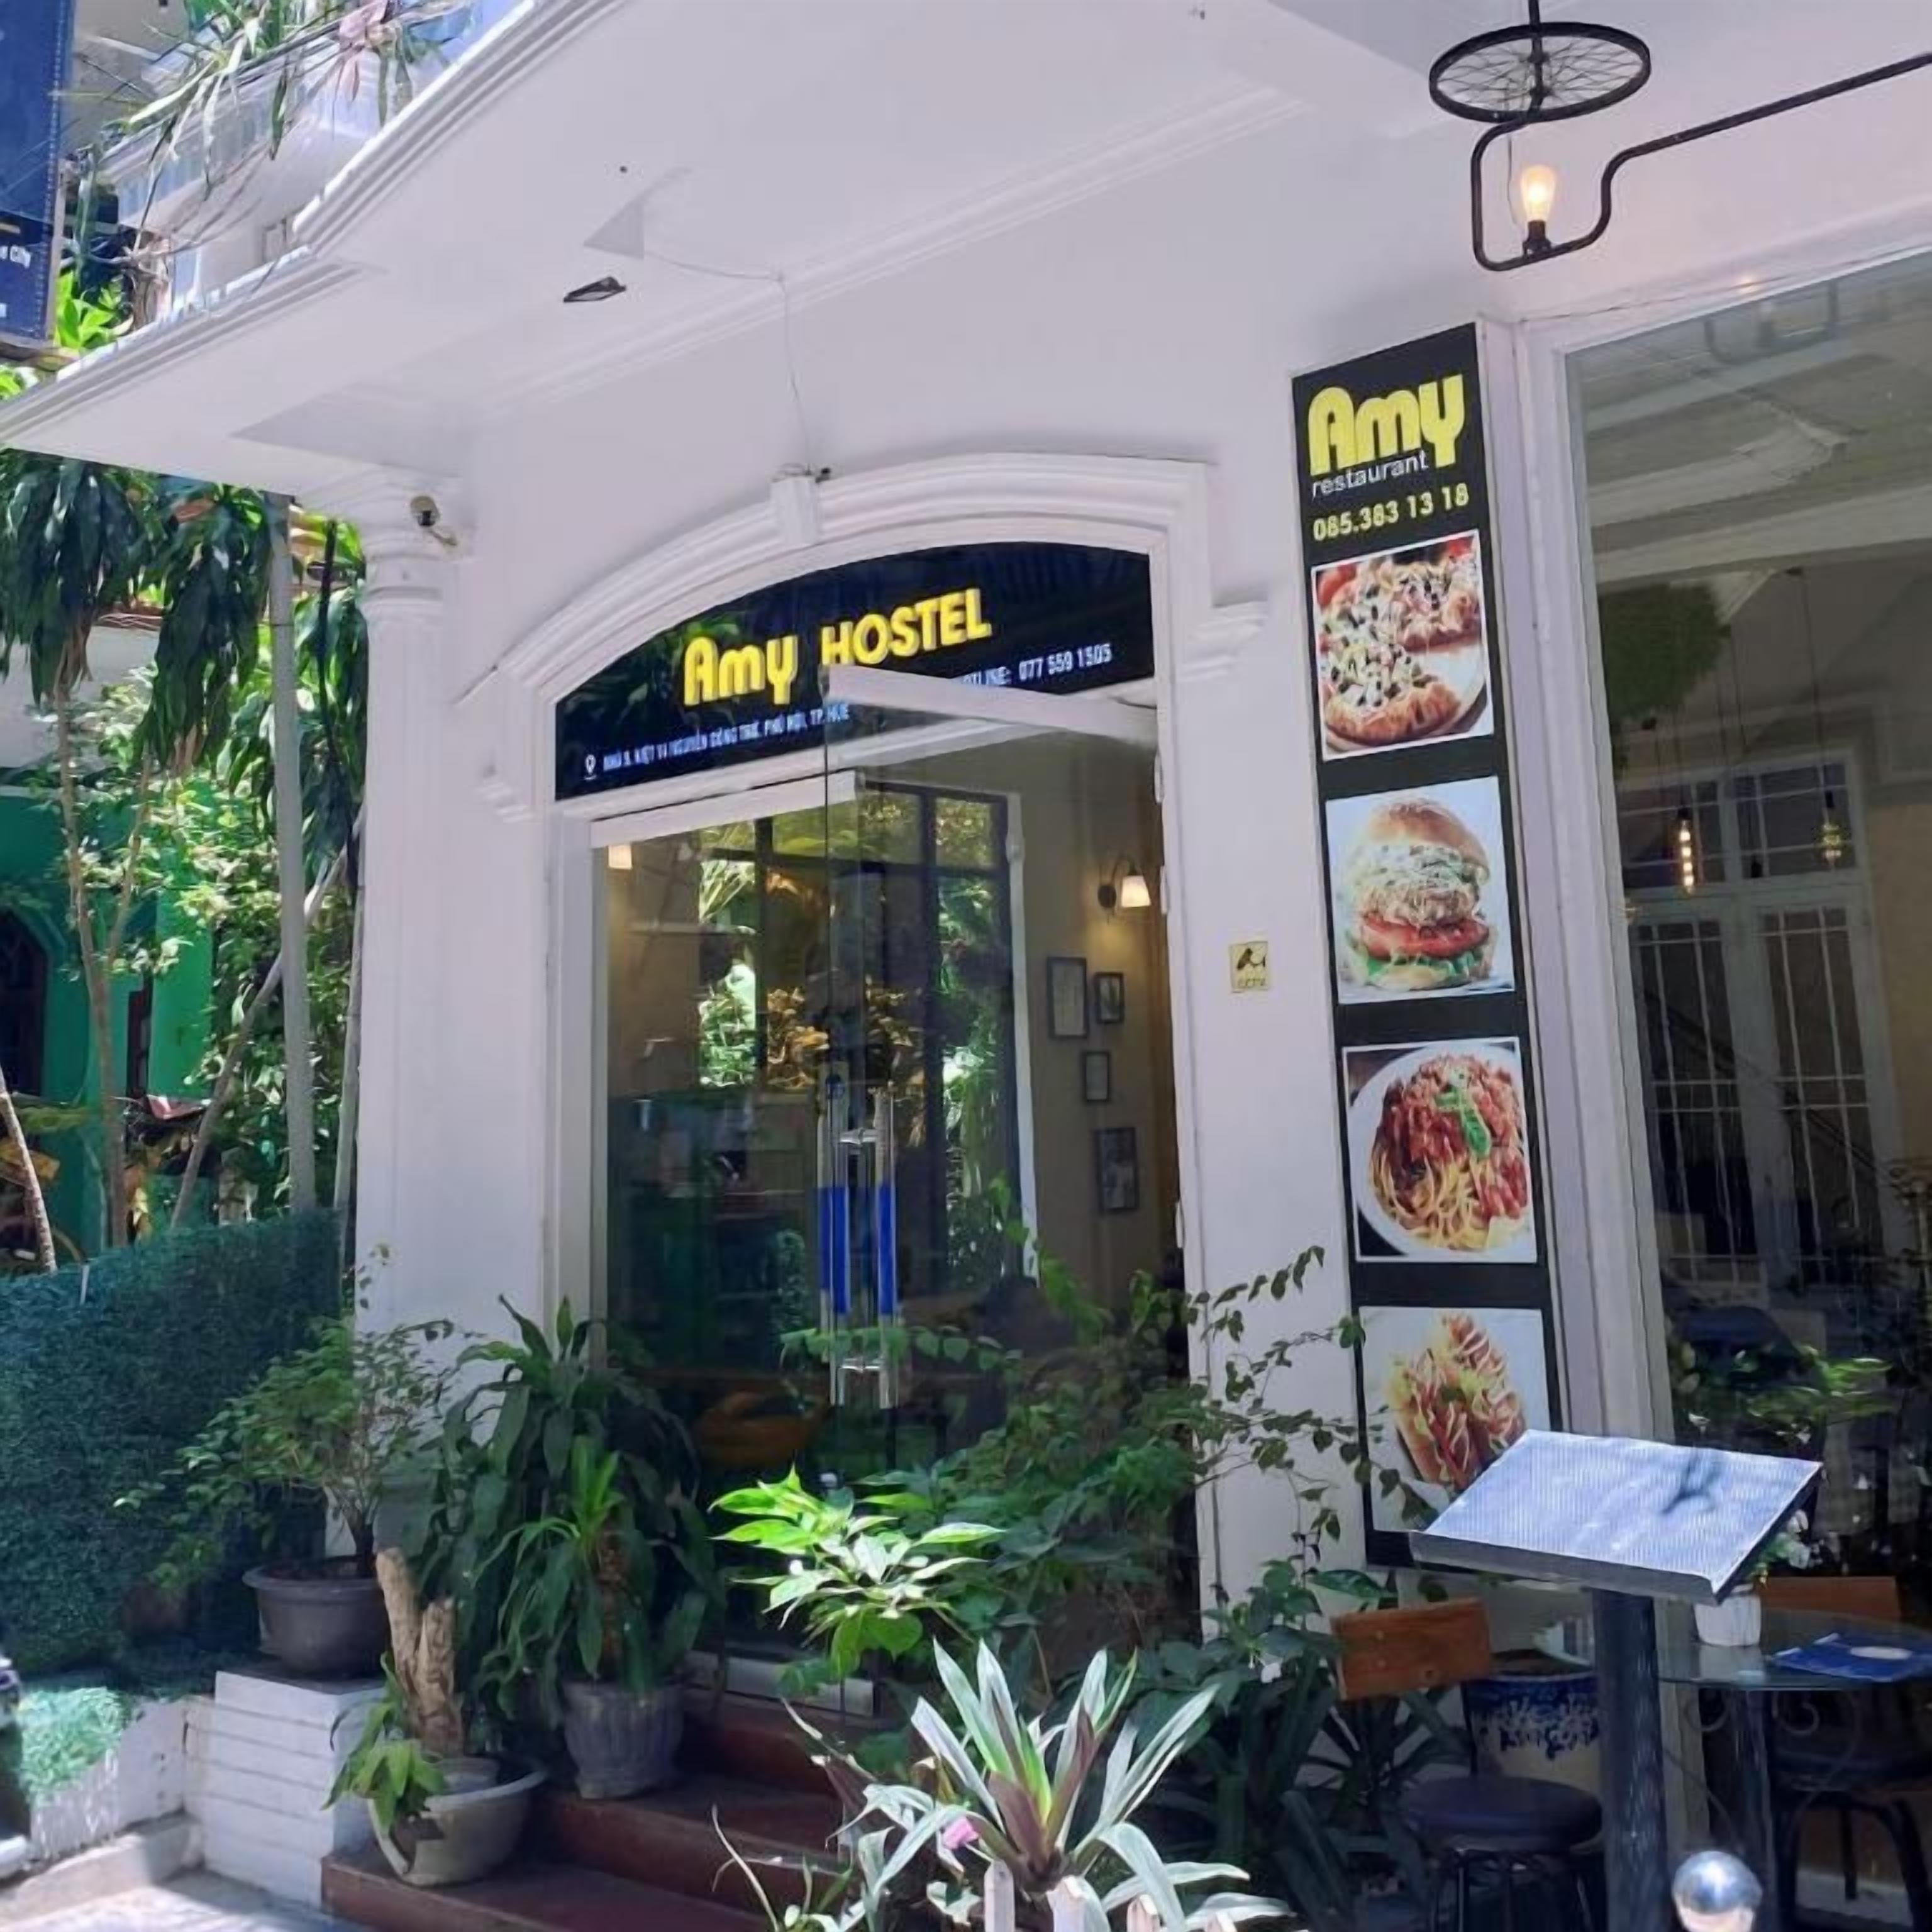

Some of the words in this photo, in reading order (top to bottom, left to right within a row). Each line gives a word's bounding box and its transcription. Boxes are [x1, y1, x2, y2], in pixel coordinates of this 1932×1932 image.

[1312, 449, 1429, 501] restaurant
[1407, 491, 1434, 518] 13
[1441, 482, 1470, 511] 18
[821, 588, 992, 667] HOSTEL
